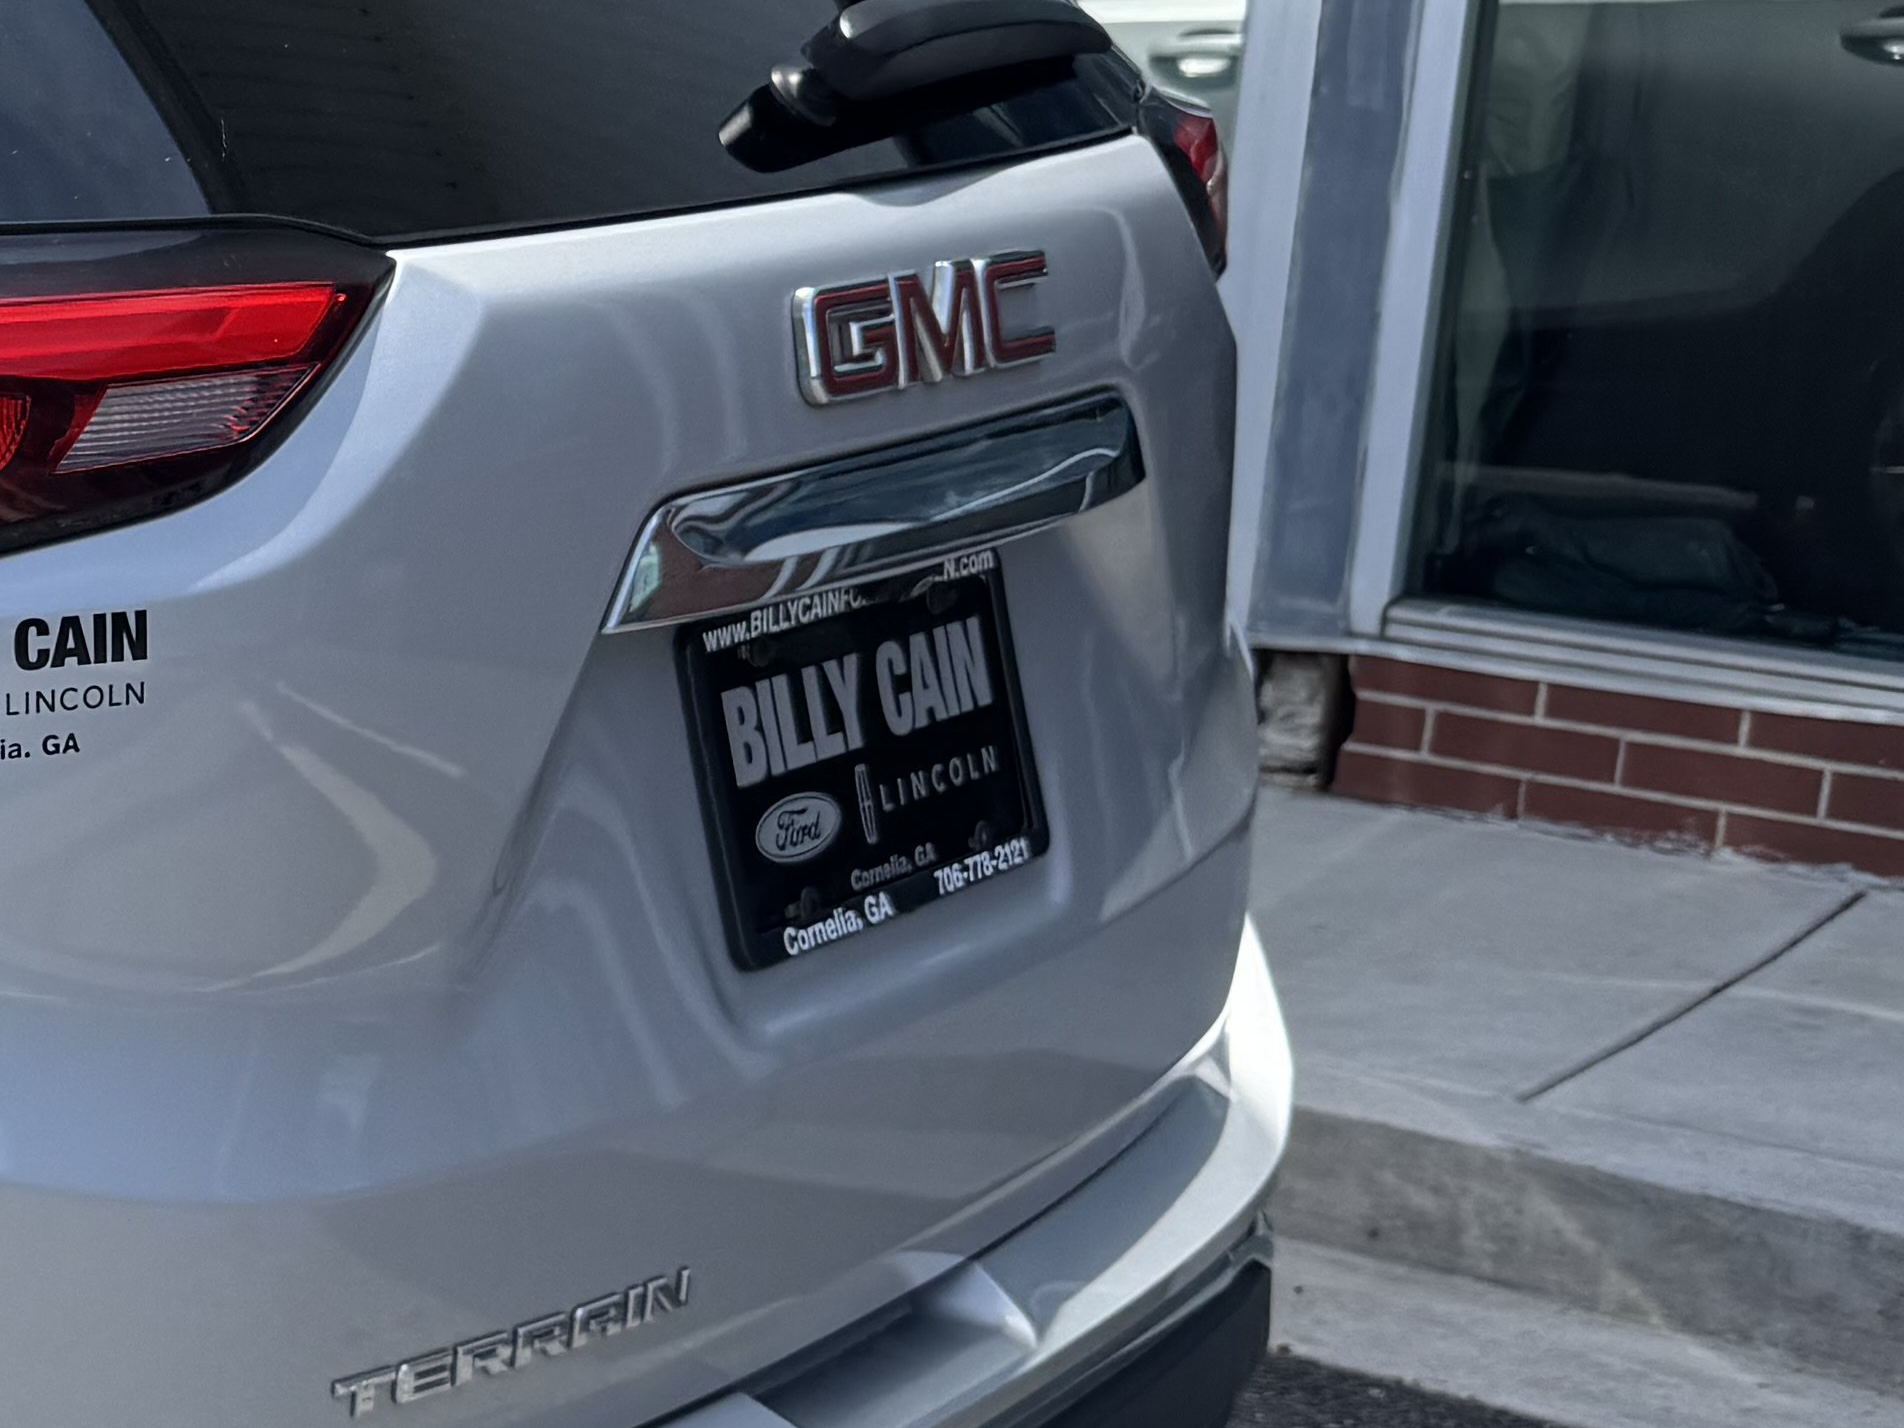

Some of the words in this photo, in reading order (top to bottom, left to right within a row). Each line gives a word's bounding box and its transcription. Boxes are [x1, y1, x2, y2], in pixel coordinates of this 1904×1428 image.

[791, 248, 1056, 408] GMC
[14, 609, 149, 671] CAIN
[6, 681, 145, 717] LINCOLN
[721, 652, 865, 788] BILLY
[876, 616, 995, 737] CAIN
[42, 733, 80, 756] GA
[879, 745, 1001, 813] LINCOLN
[864, 891, 894, 924] GA
[933, 836, 1030, 895] 706-778-2121
[914, 842, 937, 866] GA
[330, 1265, 691, 1419] TERRAIN
